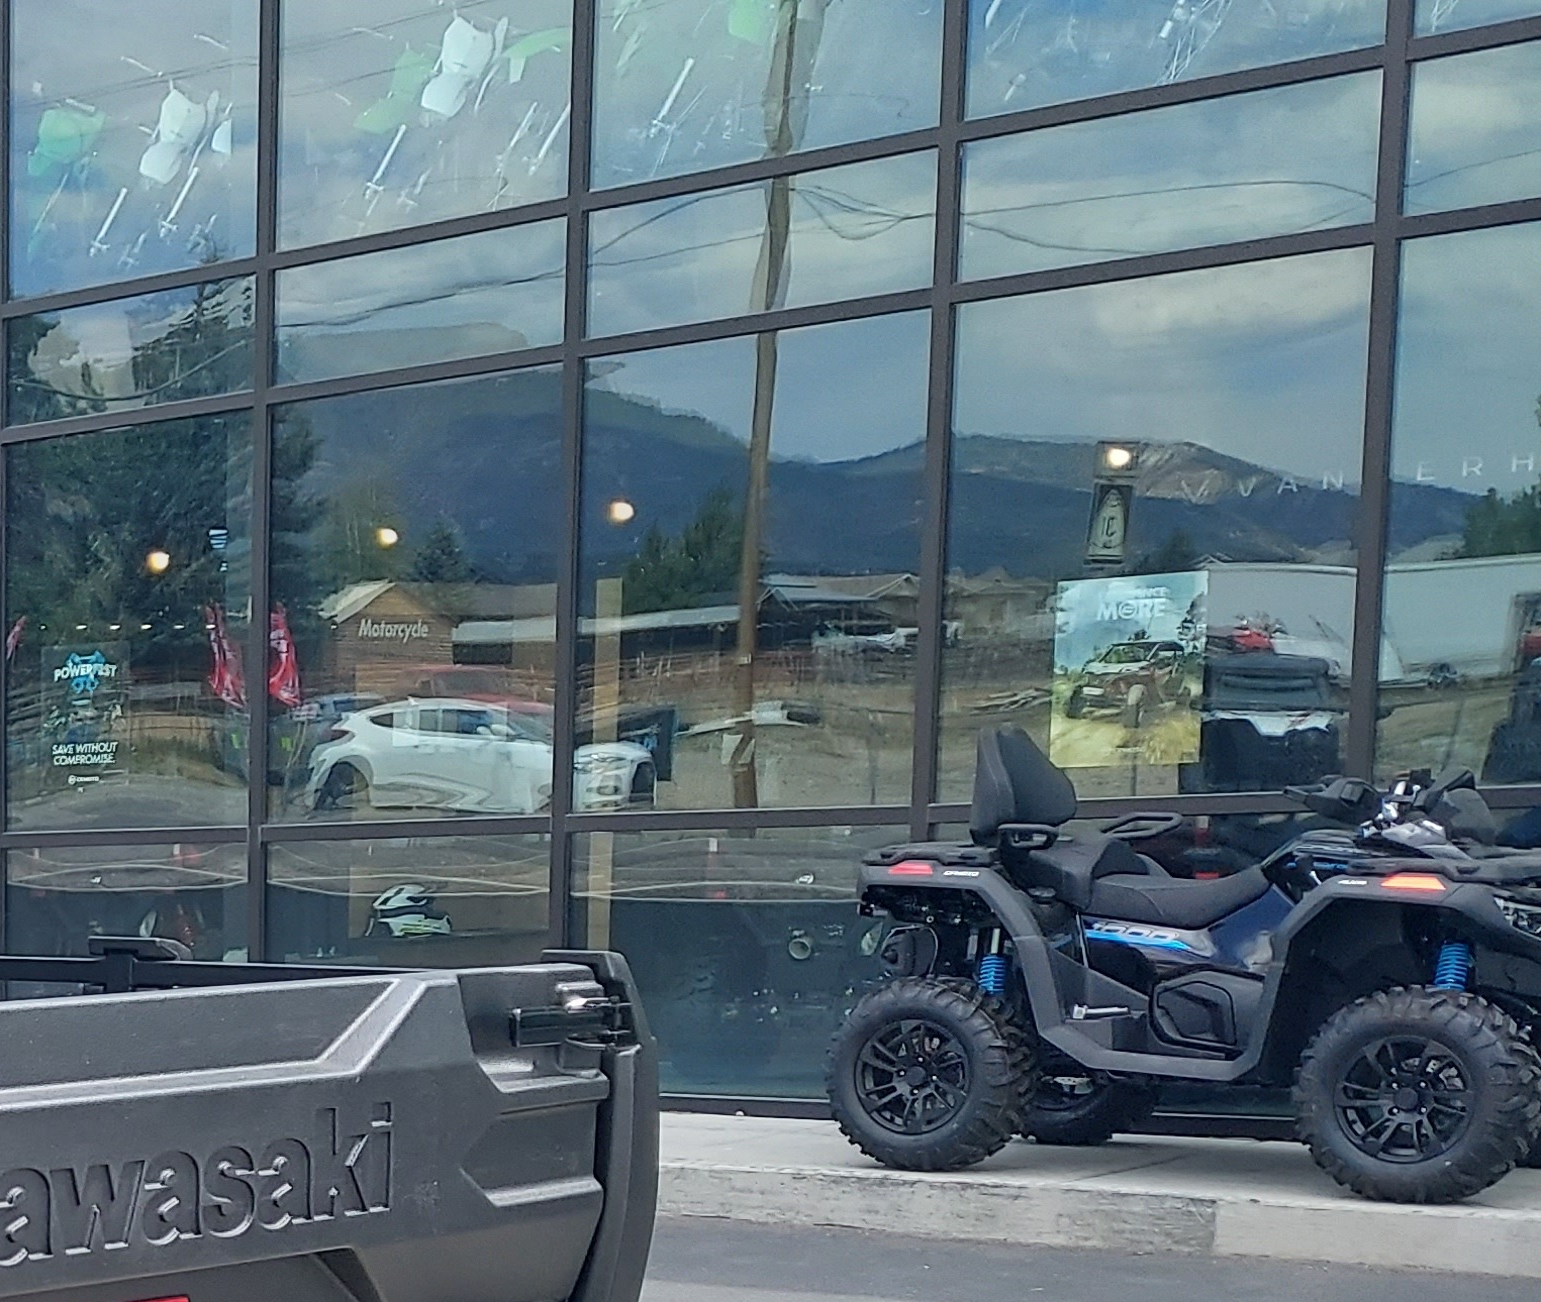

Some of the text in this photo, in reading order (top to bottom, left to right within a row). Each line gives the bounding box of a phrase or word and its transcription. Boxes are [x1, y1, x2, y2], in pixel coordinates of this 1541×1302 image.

[358, 618, 430, 644] Motorcycle
[53, 662, 118, 682] POWERFEST
[52, 741, 118, 755] SAVE WITHOUT
